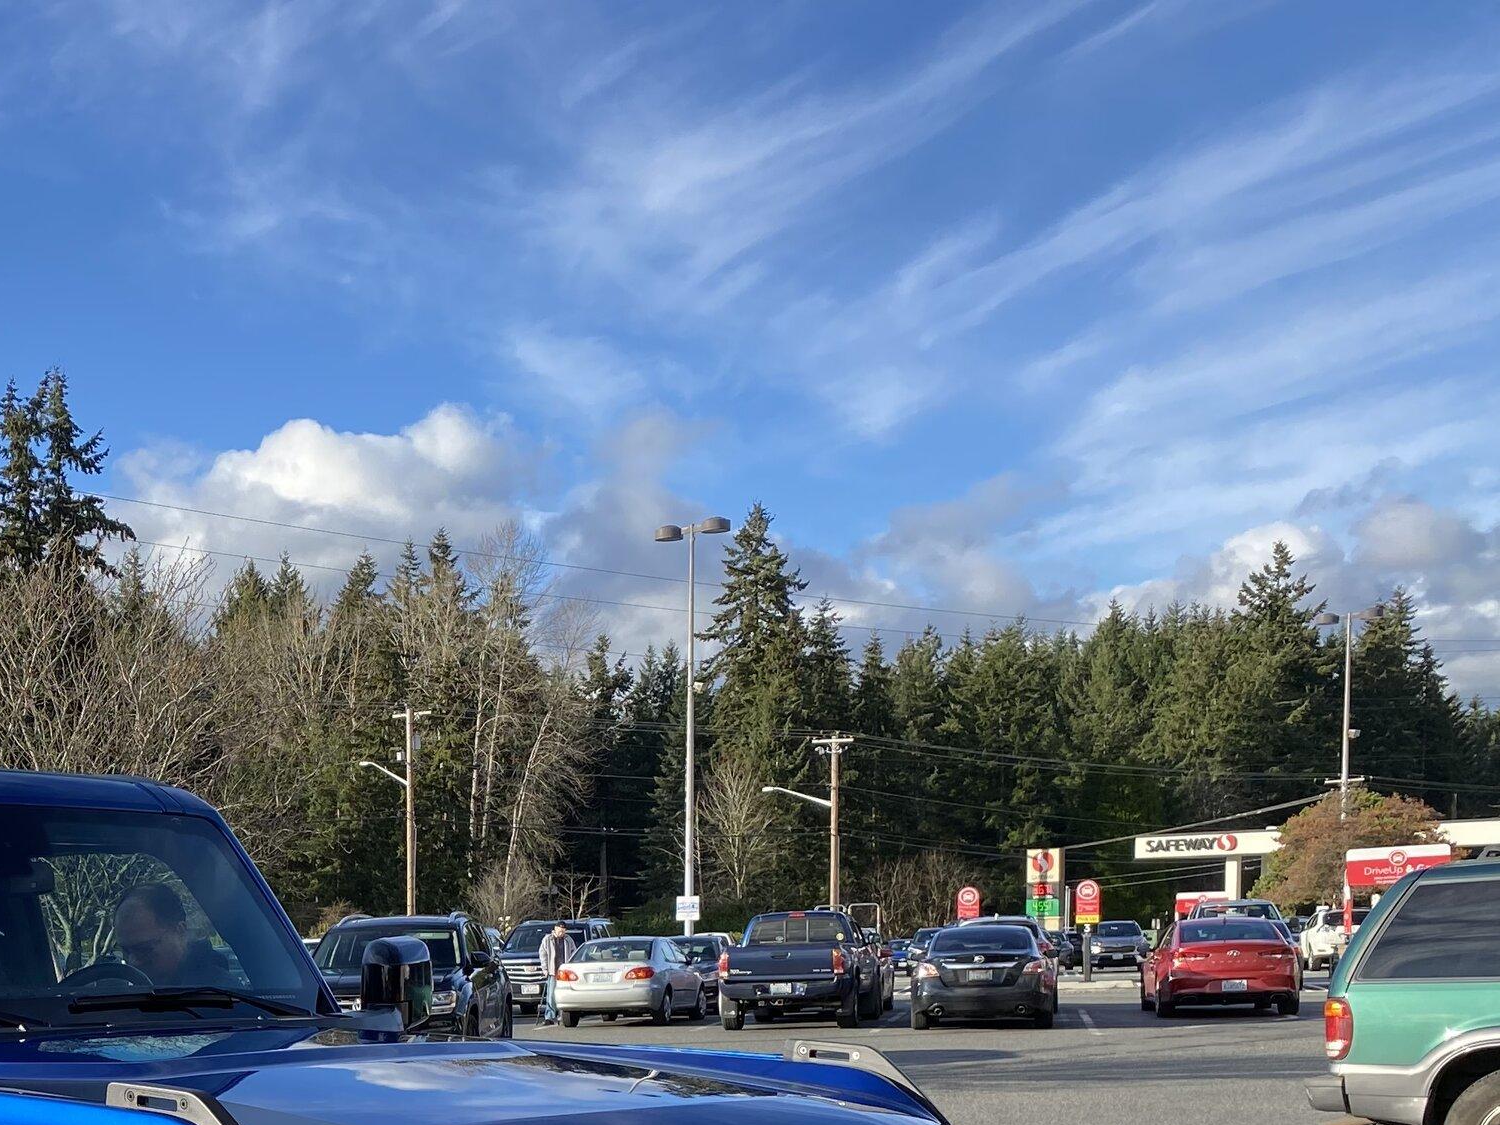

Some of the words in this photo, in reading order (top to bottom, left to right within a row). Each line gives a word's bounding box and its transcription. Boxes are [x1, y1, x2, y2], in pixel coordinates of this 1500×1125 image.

[1145, 837, 1217, 853] SAFEWAY
[1364, 866, 1403, 877] DriveUp
[1084, 924, 1090, 932] 3
